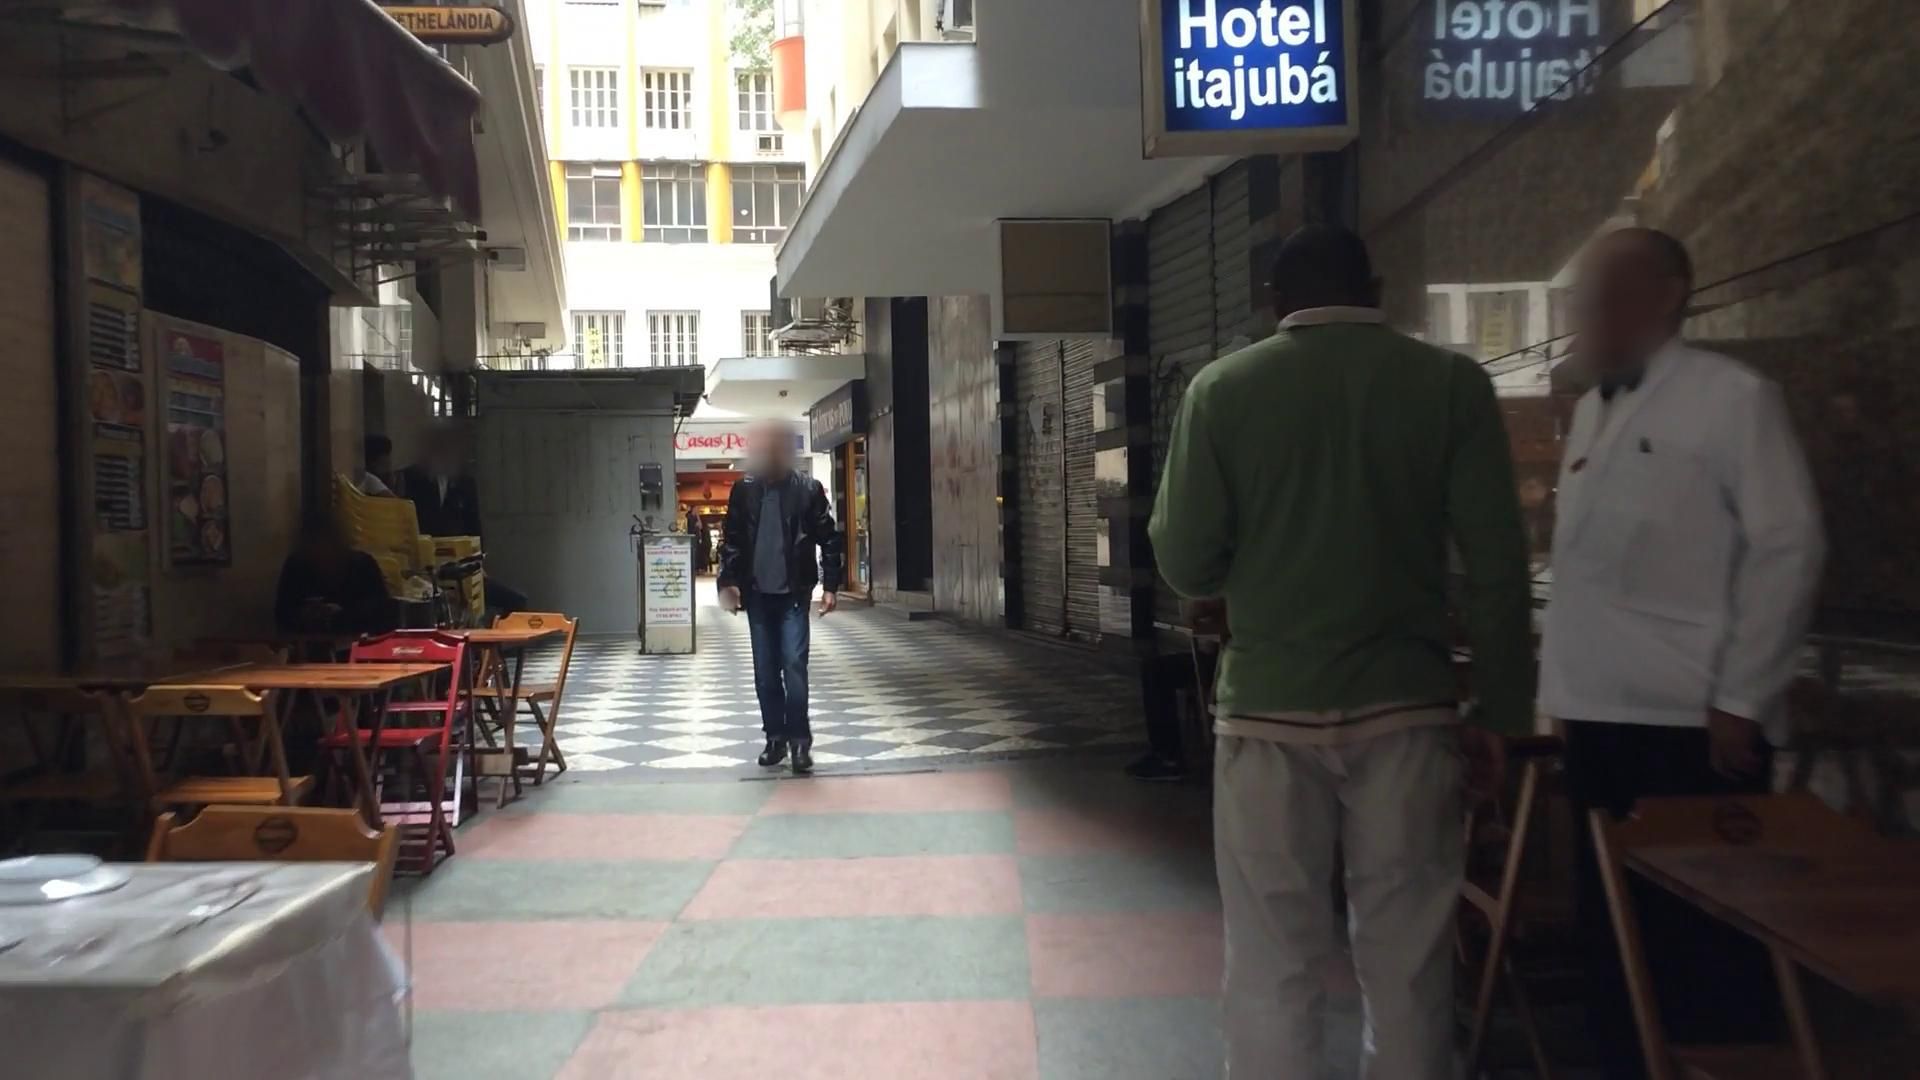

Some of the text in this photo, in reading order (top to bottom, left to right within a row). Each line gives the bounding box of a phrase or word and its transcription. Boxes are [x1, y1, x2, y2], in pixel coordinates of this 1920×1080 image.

[1179, 0, 1326, 48] Hotel
[1174, 51, 1338, 120] itajubá
[673, 432, 722, 450] Casas
